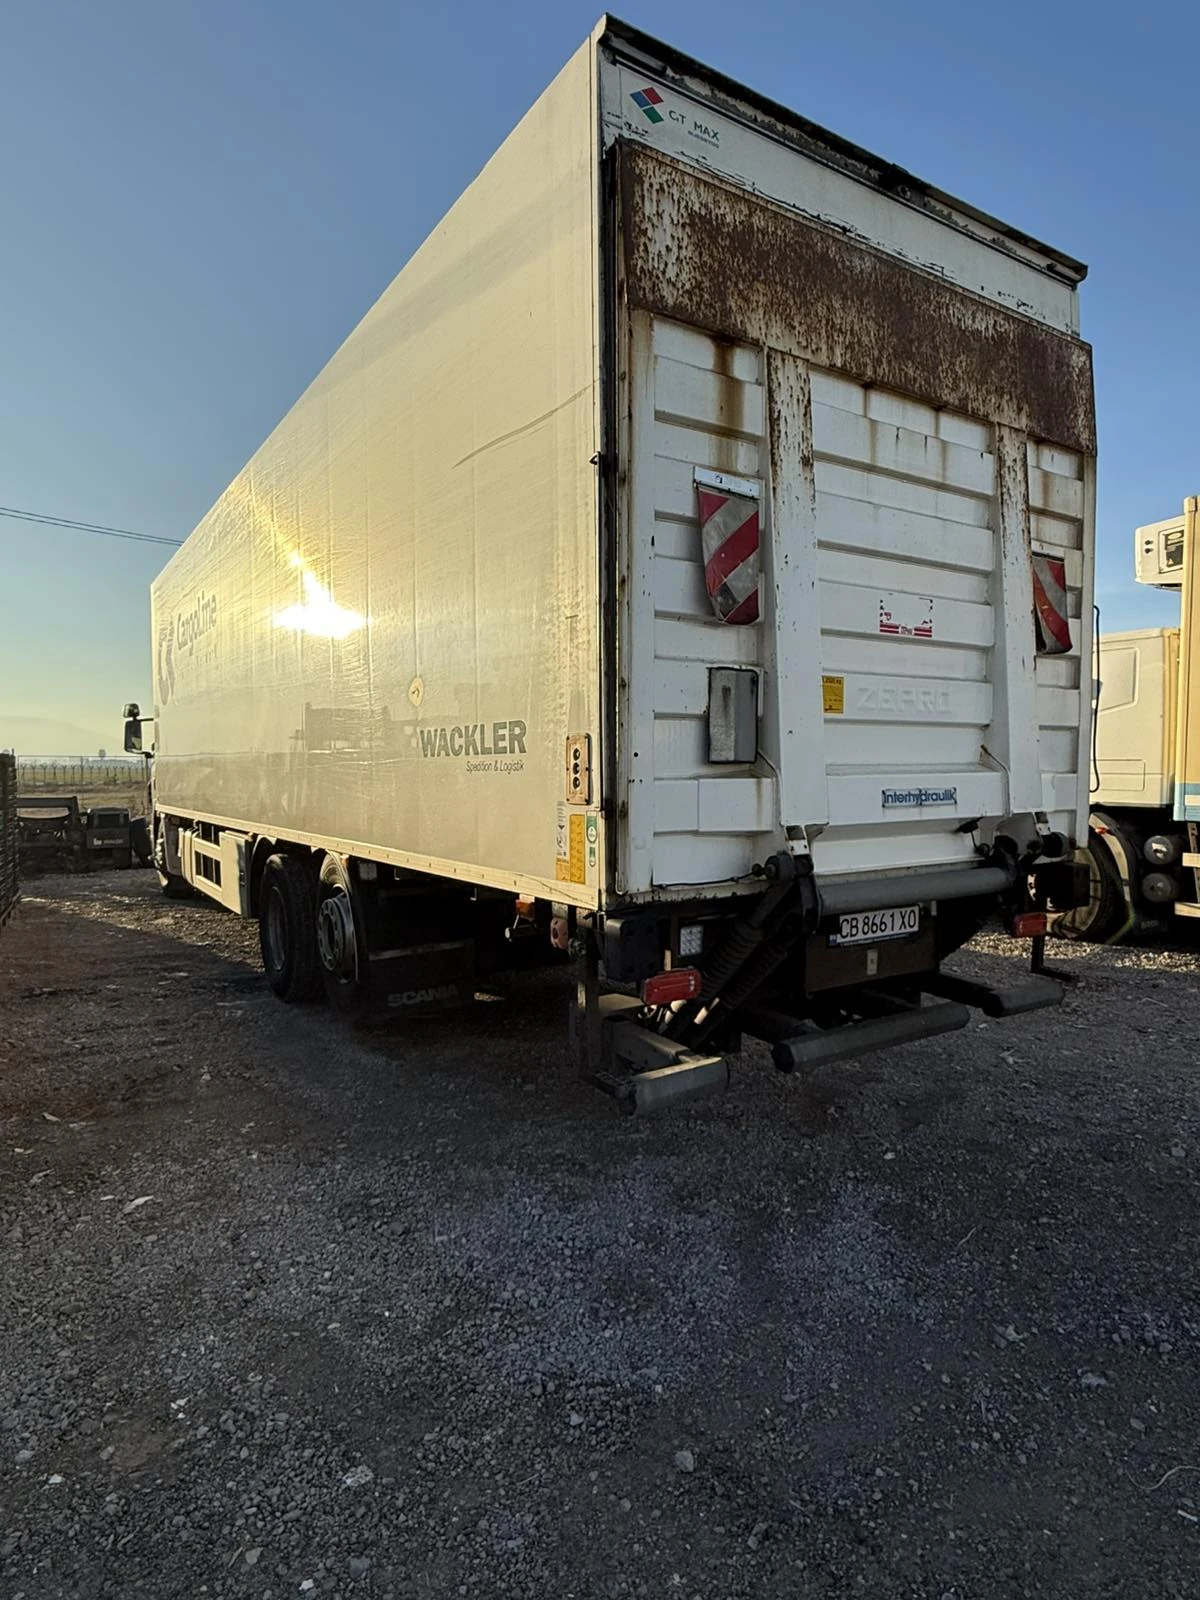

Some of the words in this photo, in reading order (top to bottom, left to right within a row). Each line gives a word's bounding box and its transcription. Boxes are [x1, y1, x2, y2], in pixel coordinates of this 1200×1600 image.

[668, 110, 687, 125] CT
[693, 121, 720, 141] MAX
[419, 719, 528, 758] WACKLER
[499, 759, 525, 775] Logistik
[884, 787, 956, 806] interhydraulik
[840, 918, 859, 939] CB
[861, 912, 896, 935] 8661
[387, 984, 461, 1007] SCANIA
